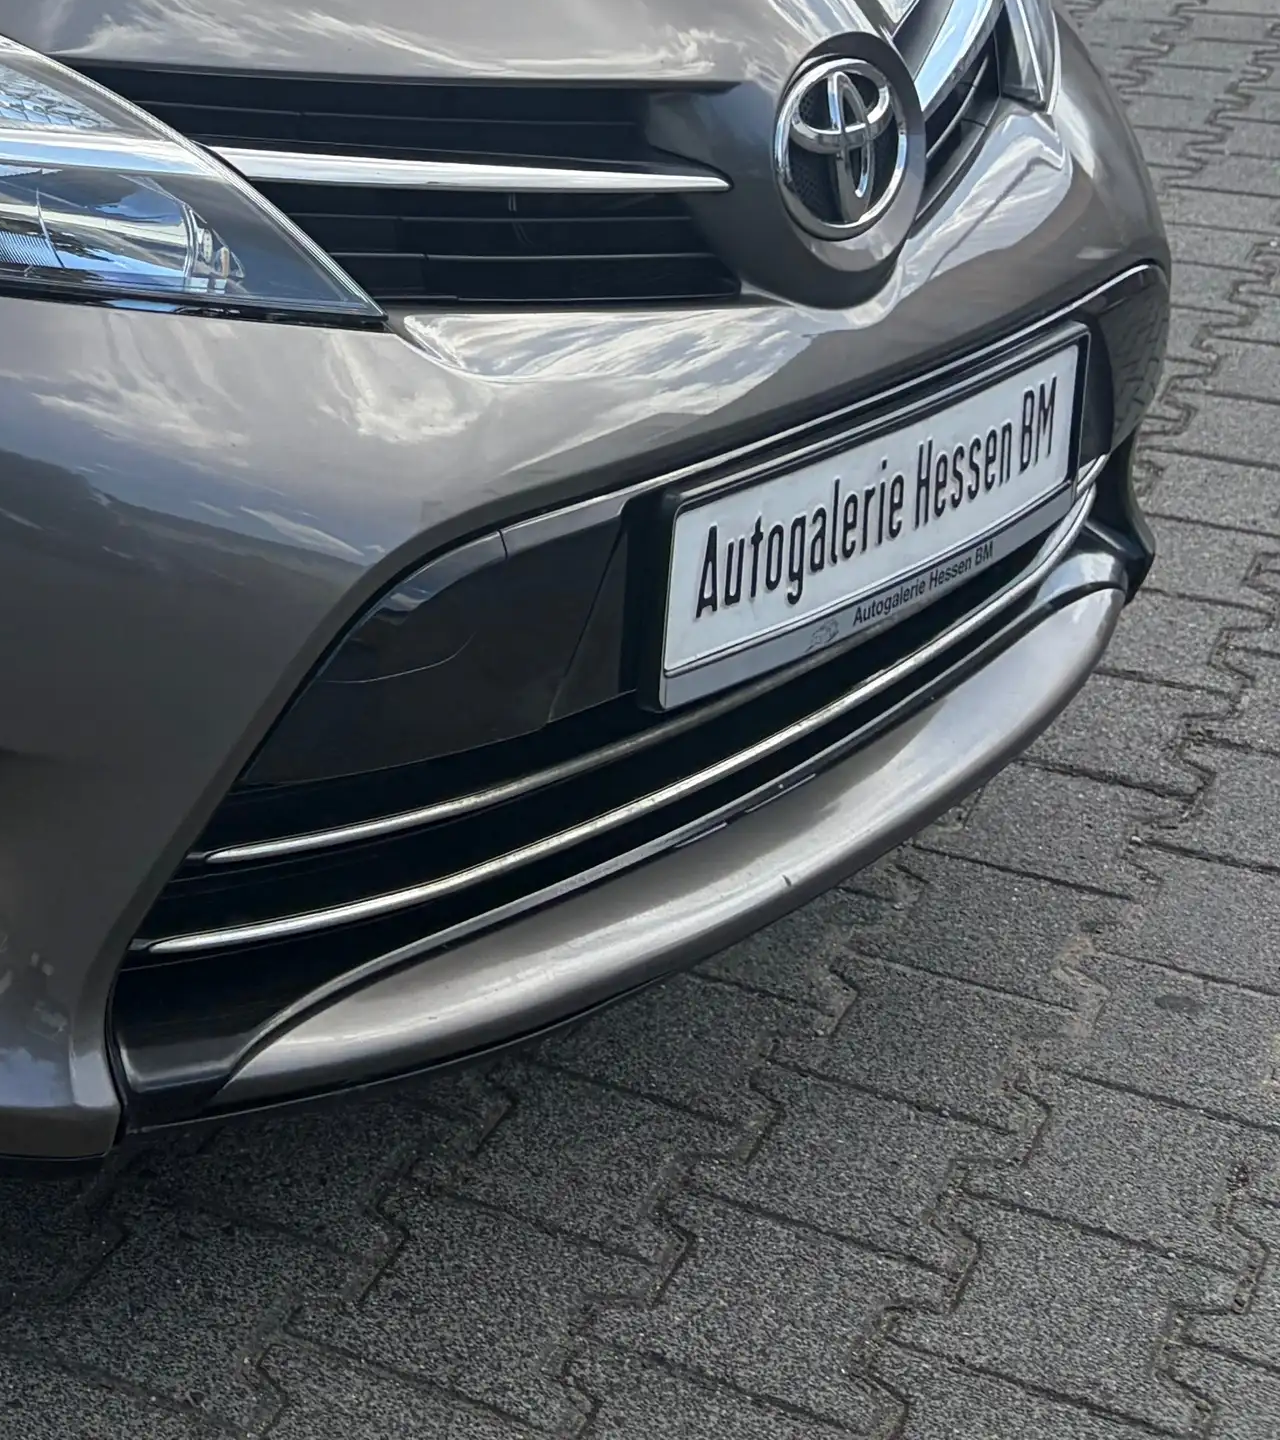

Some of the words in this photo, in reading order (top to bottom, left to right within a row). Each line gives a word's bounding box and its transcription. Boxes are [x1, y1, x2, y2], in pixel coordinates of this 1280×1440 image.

[695, 459, 905, 619] Autogalerie
[914, 419, 1013, 529] Hessen
[1019, 376, 1058, 474] BM
[852, 580, 925, 627] Autogalerie
[929, 558, 972, 592] Hessen
[975, 540, 994, 567] BM
